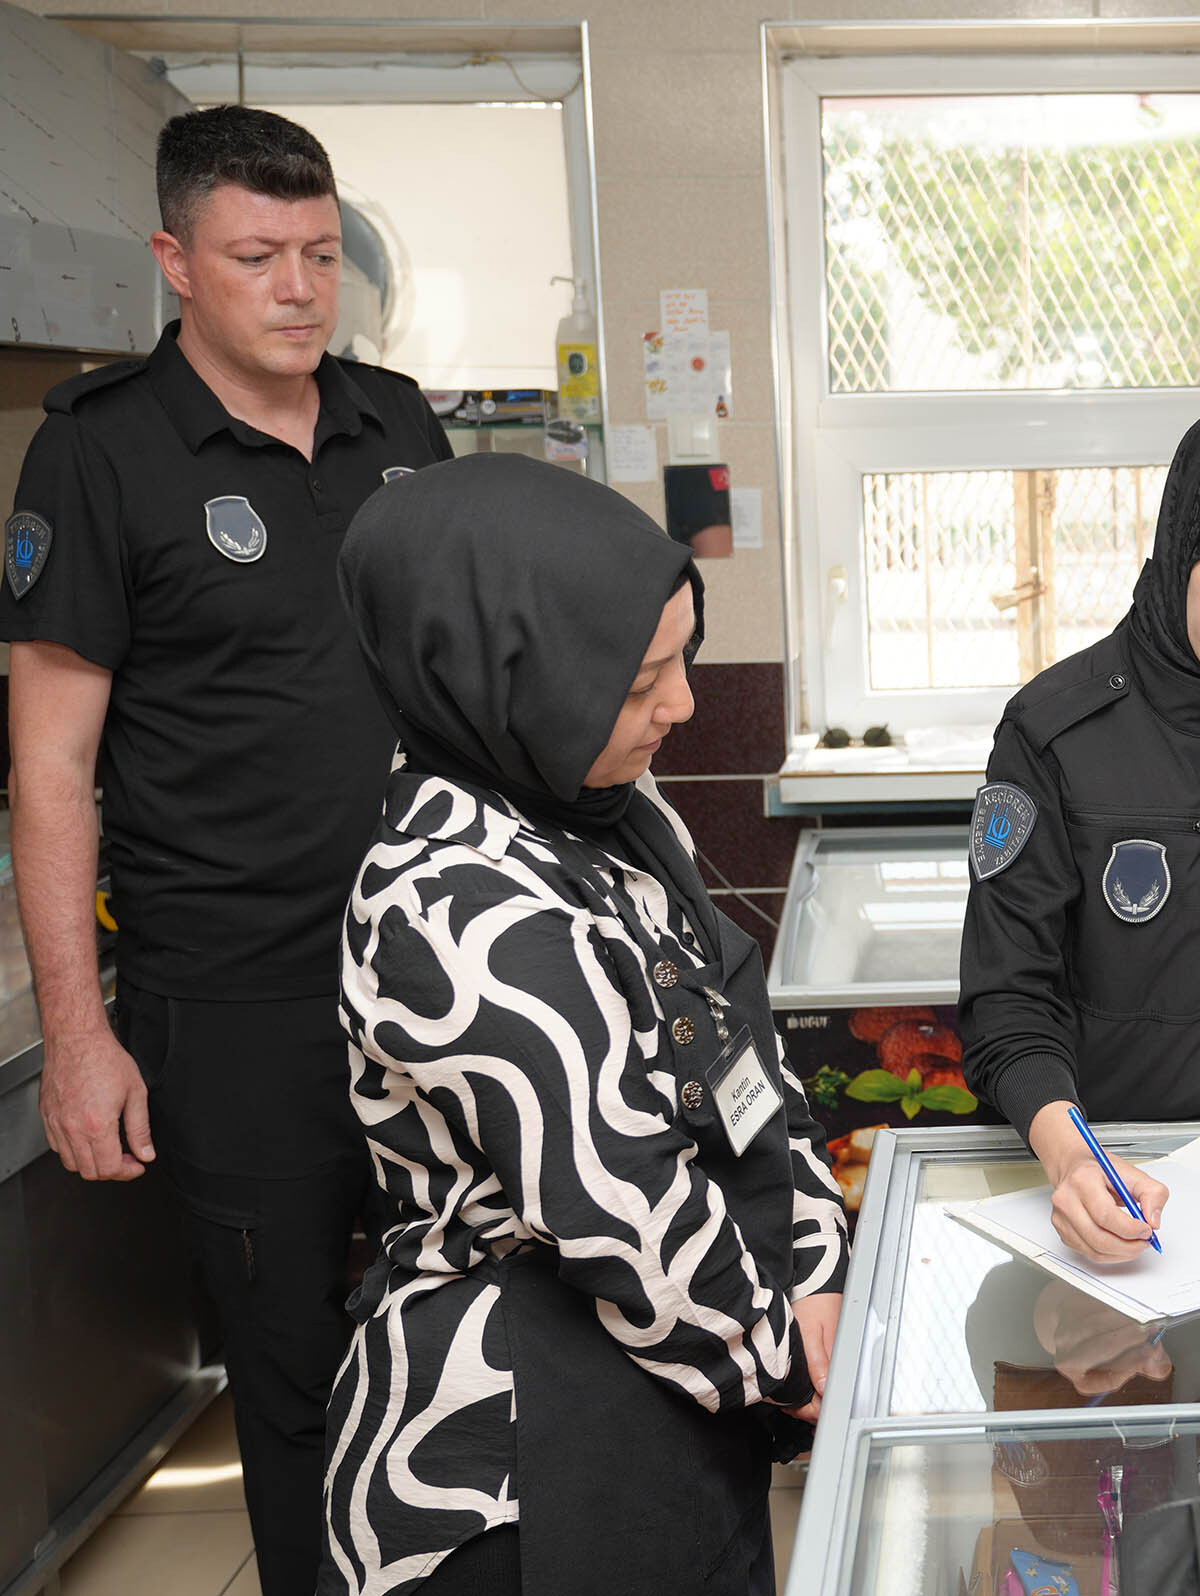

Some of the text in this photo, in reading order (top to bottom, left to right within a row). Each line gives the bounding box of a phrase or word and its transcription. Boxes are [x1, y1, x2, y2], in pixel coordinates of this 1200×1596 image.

[730, 1080, 766, 1127] ESRA ORAN
[731, 1076, 751, 1102] Kantin
